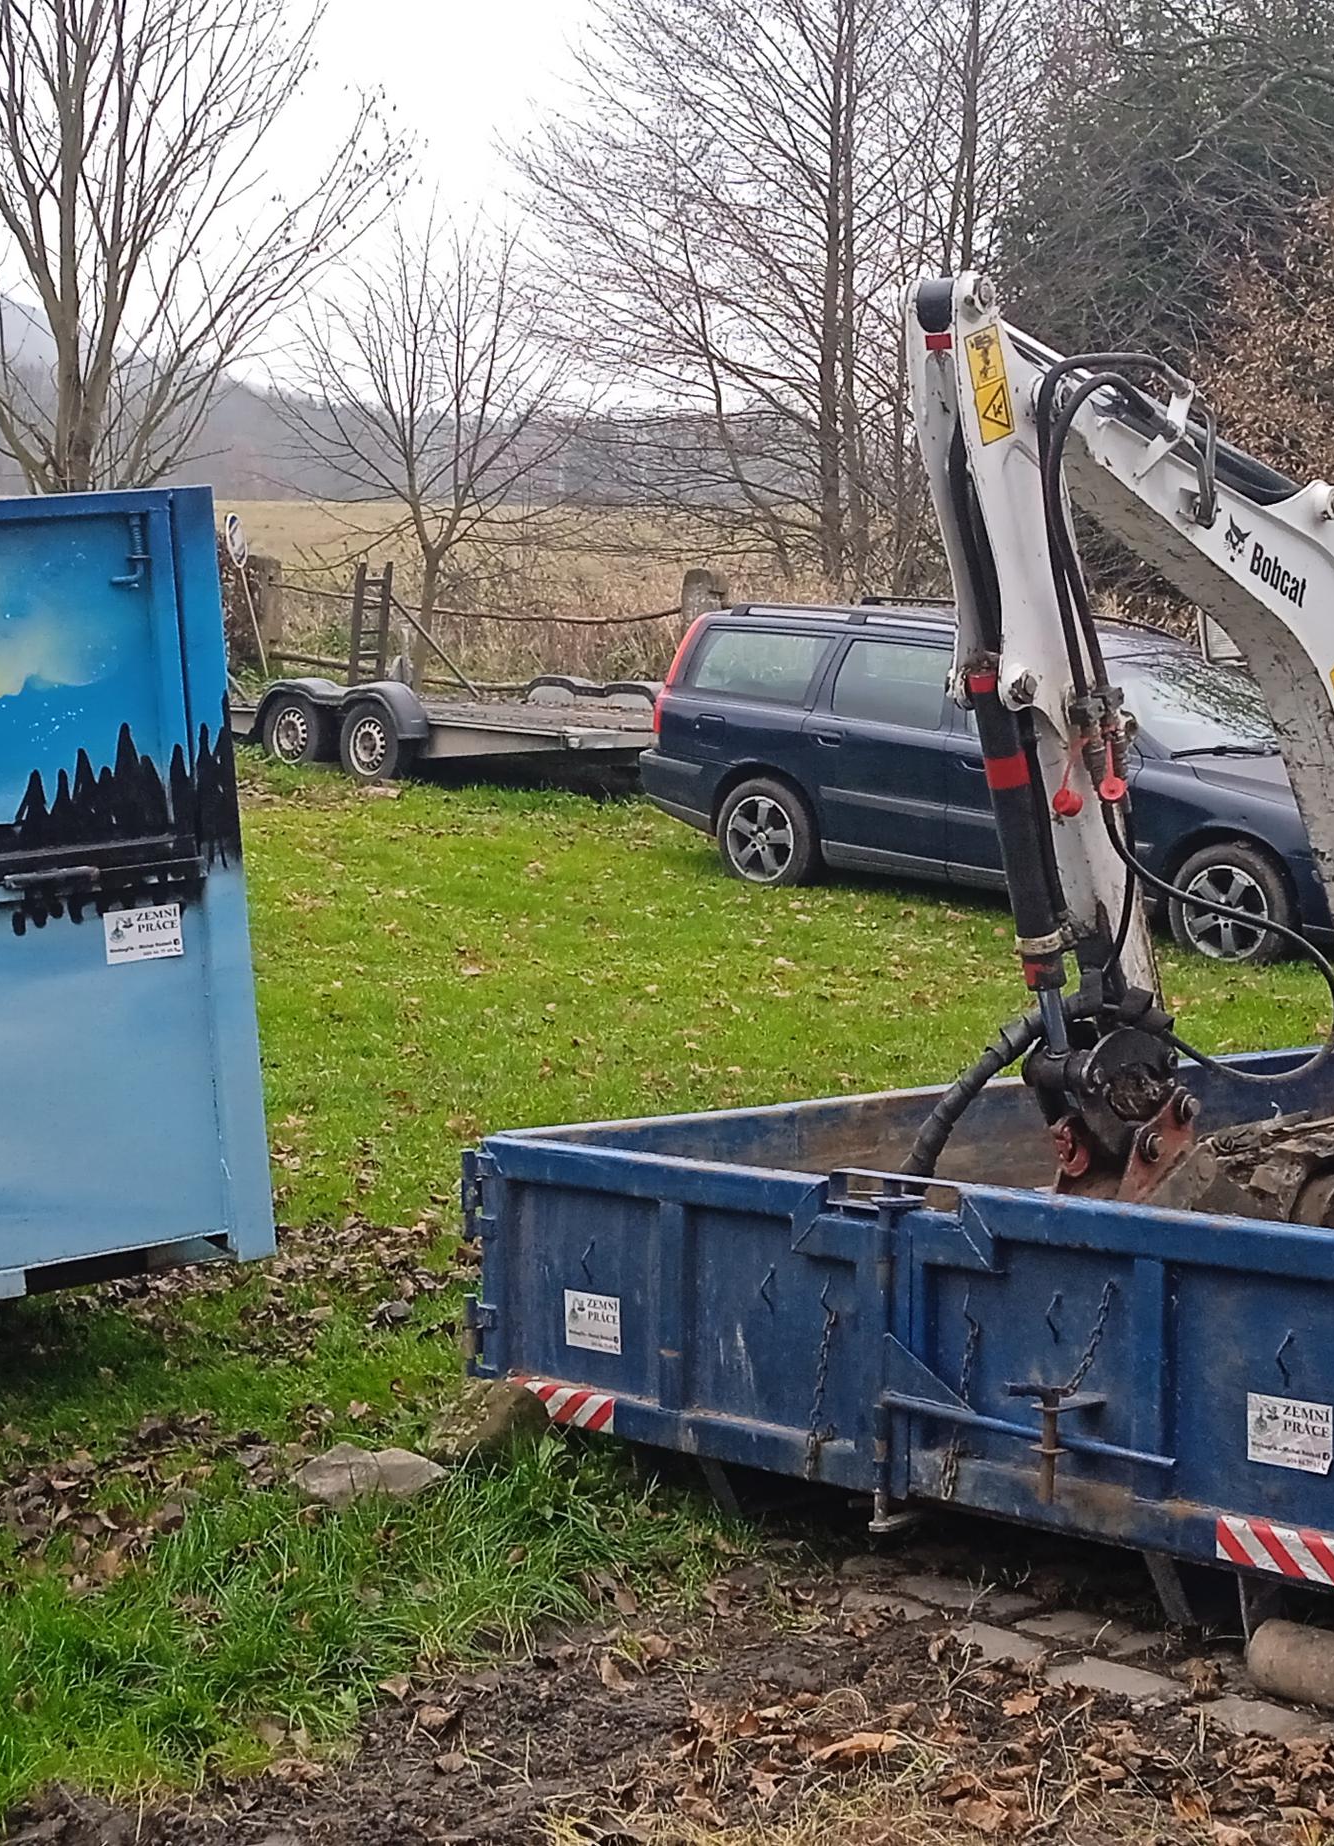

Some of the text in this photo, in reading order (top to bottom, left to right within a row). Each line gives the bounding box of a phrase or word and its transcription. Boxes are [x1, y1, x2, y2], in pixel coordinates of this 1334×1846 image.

[1250, 542, 1306, 608] Bobcat
[136, 906, 178, 922] ZEMNÍ
[137, 919, 178, 933] PRÁCE
[1283, 1404, 1330, 1423] ZEMNÍ
[1284, 1420, 1330, 1438] PRÁCE
